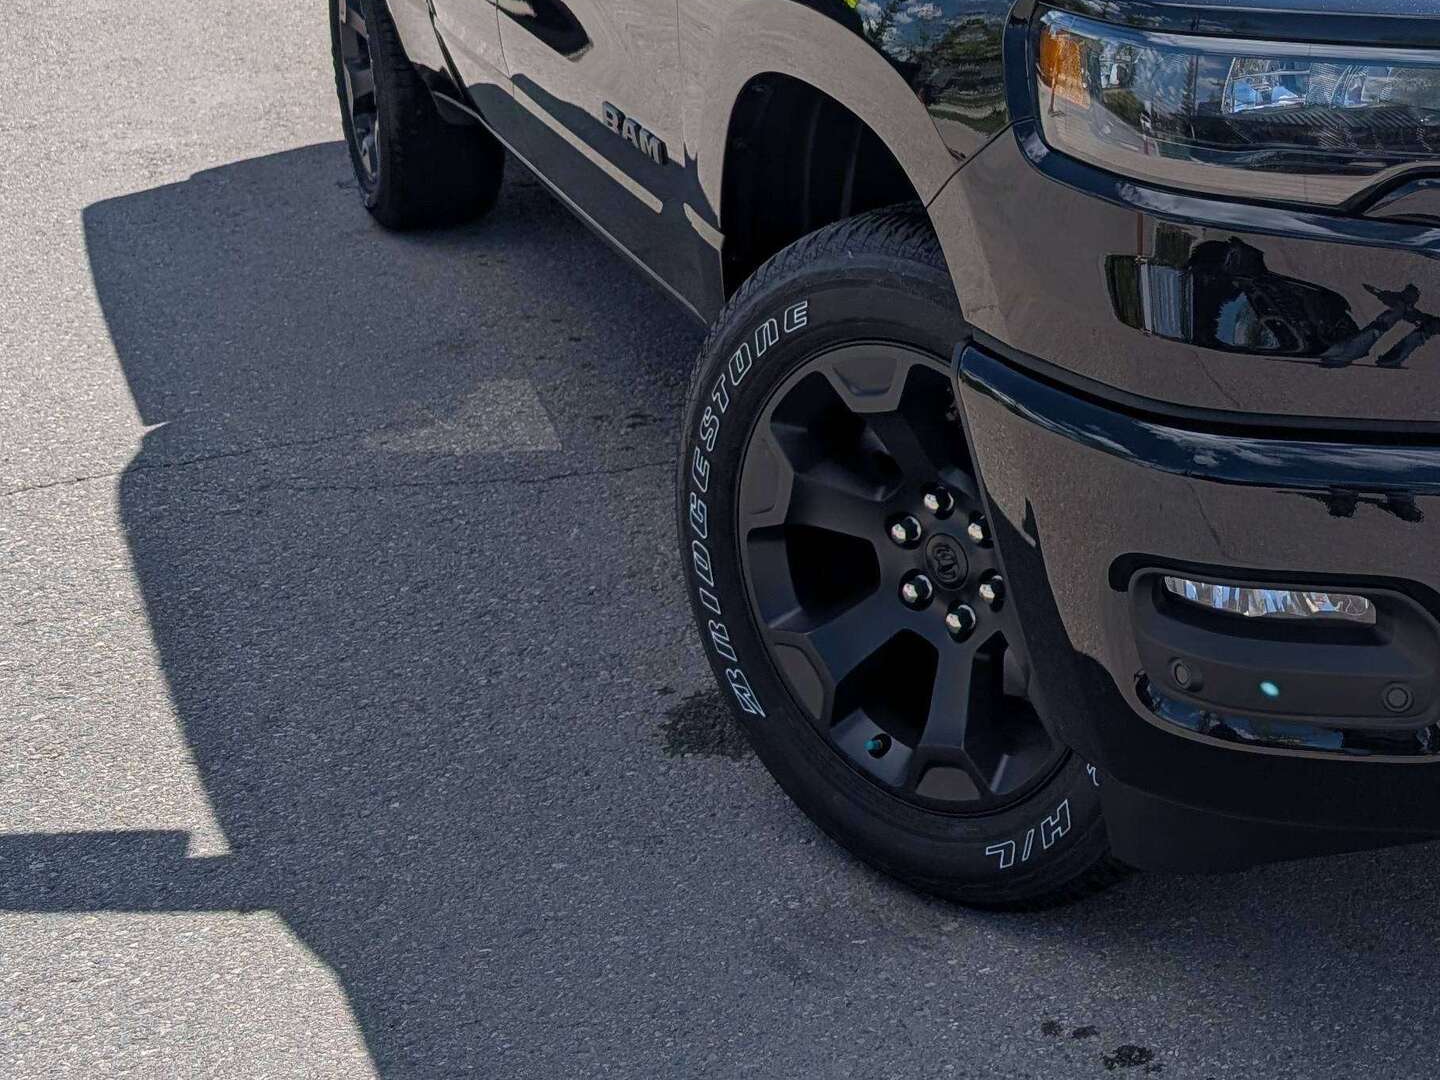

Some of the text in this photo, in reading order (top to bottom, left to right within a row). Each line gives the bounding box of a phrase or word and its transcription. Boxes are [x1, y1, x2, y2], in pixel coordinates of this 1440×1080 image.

[601, 100, 669, 166] RAM
[687, 300, 810, 718] BRIDGESTONE
[984, 798, 1073, 870] H/L
